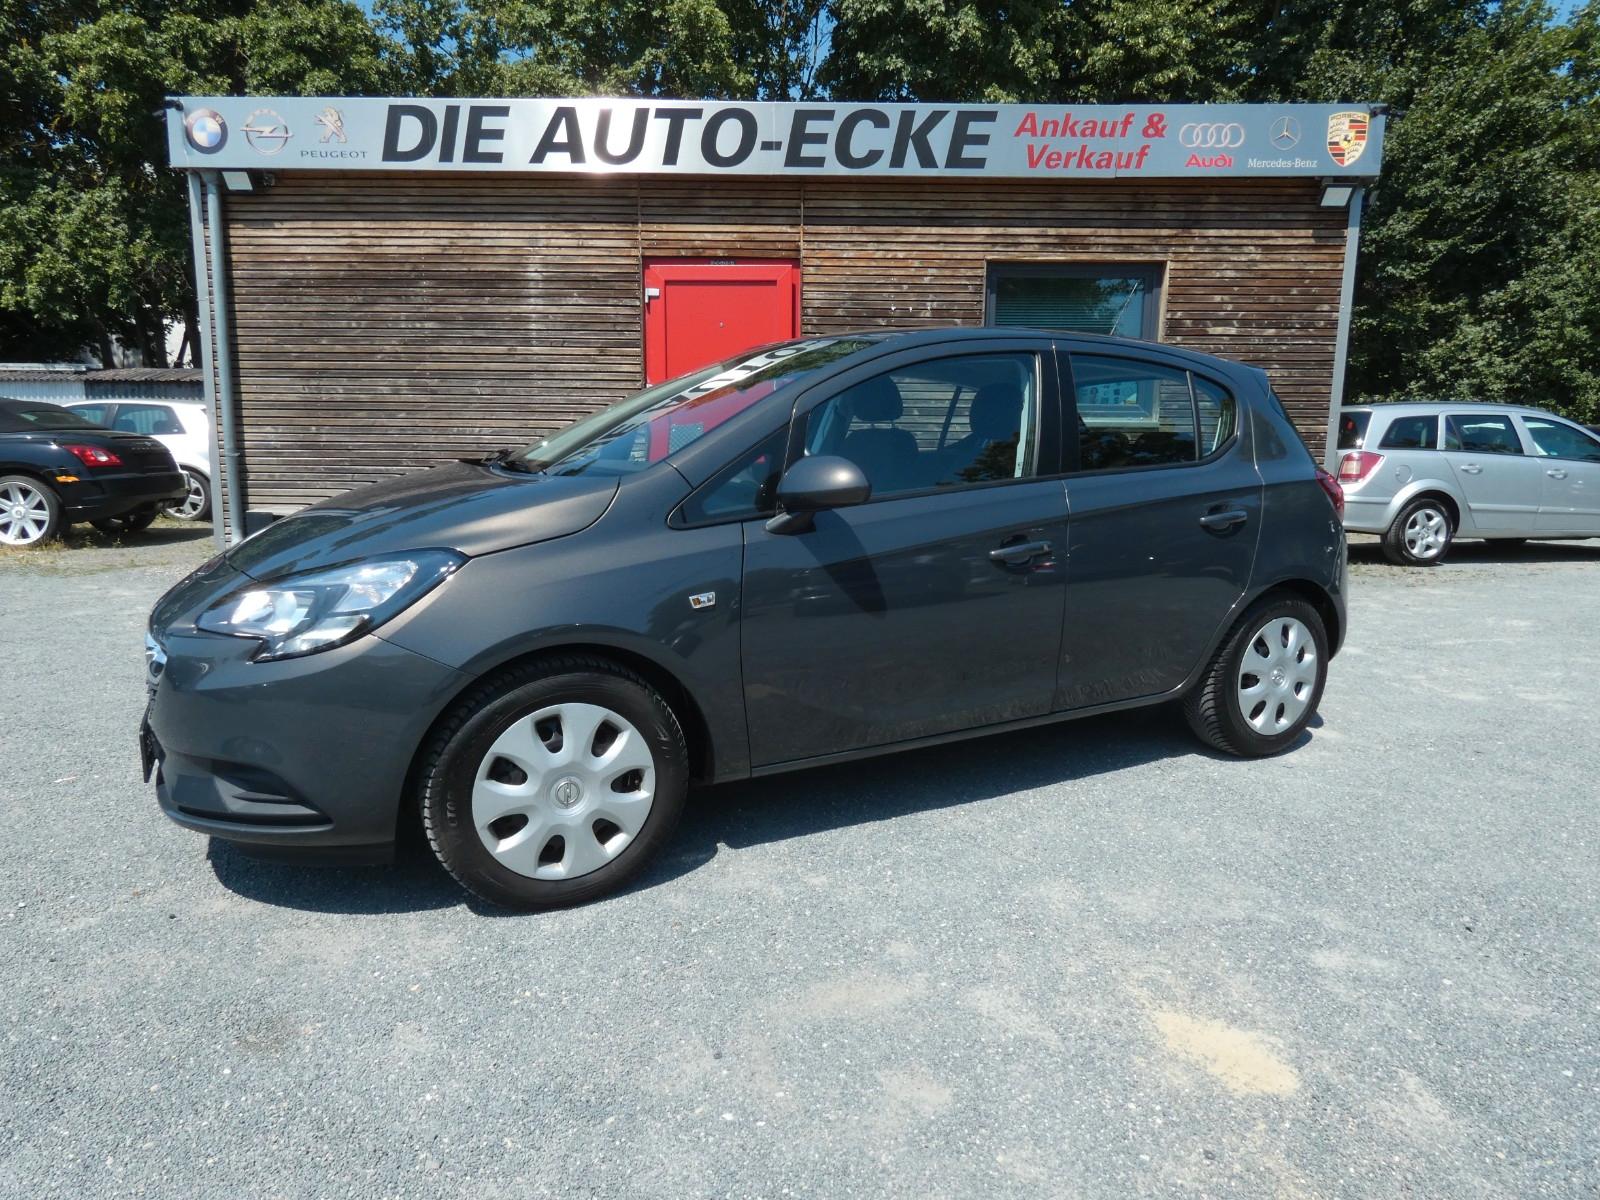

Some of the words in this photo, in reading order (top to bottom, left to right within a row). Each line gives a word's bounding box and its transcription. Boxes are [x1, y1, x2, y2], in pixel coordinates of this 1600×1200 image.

[1013, 111, 1135, 139] Ankauf
[1141, 112, 1168, 139] &
[381, 104, 511, 164] DIE
[528, 105, 998, 170] AUTO-ECKE
[299, 150, 368, 159] PEUGEOT
[1026, 144, 1151, 170] Verkauf
[1184, 153, 1233, 168] Audi
[1247, 158, 1319, 168] Mercedes-Benz
